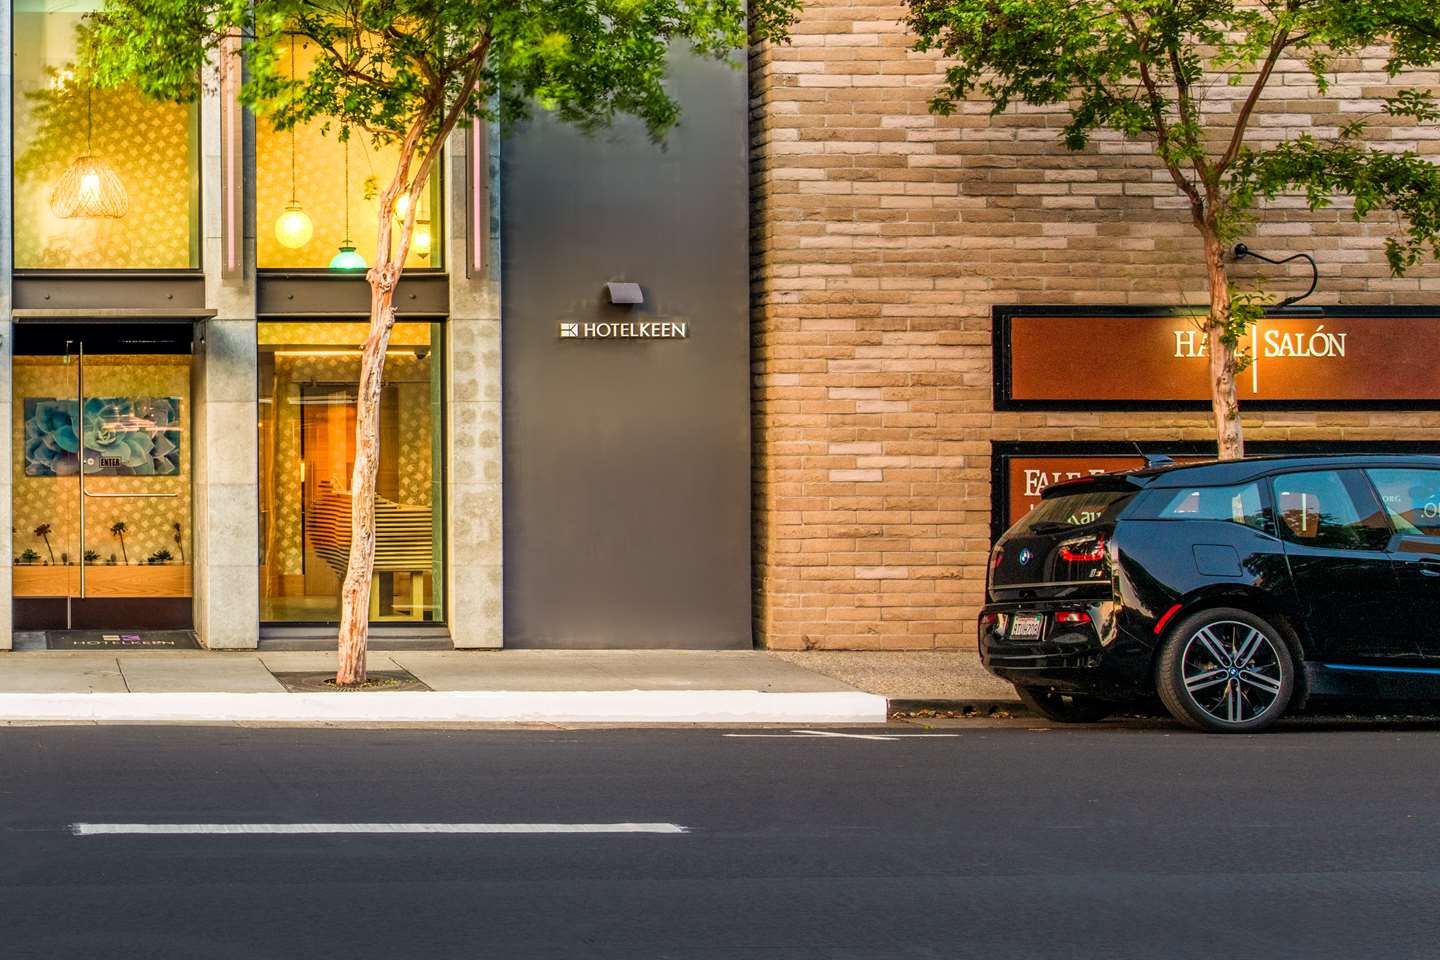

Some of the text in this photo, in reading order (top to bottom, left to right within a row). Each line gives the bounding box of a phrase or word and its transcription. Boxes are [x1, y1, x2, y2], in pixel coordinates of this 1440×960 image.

[584, 323, 686, 337] HOTELKEEN
[1264, 325, 1347, 357] SALÓN
[100, 458, 120, 467] ENTER
